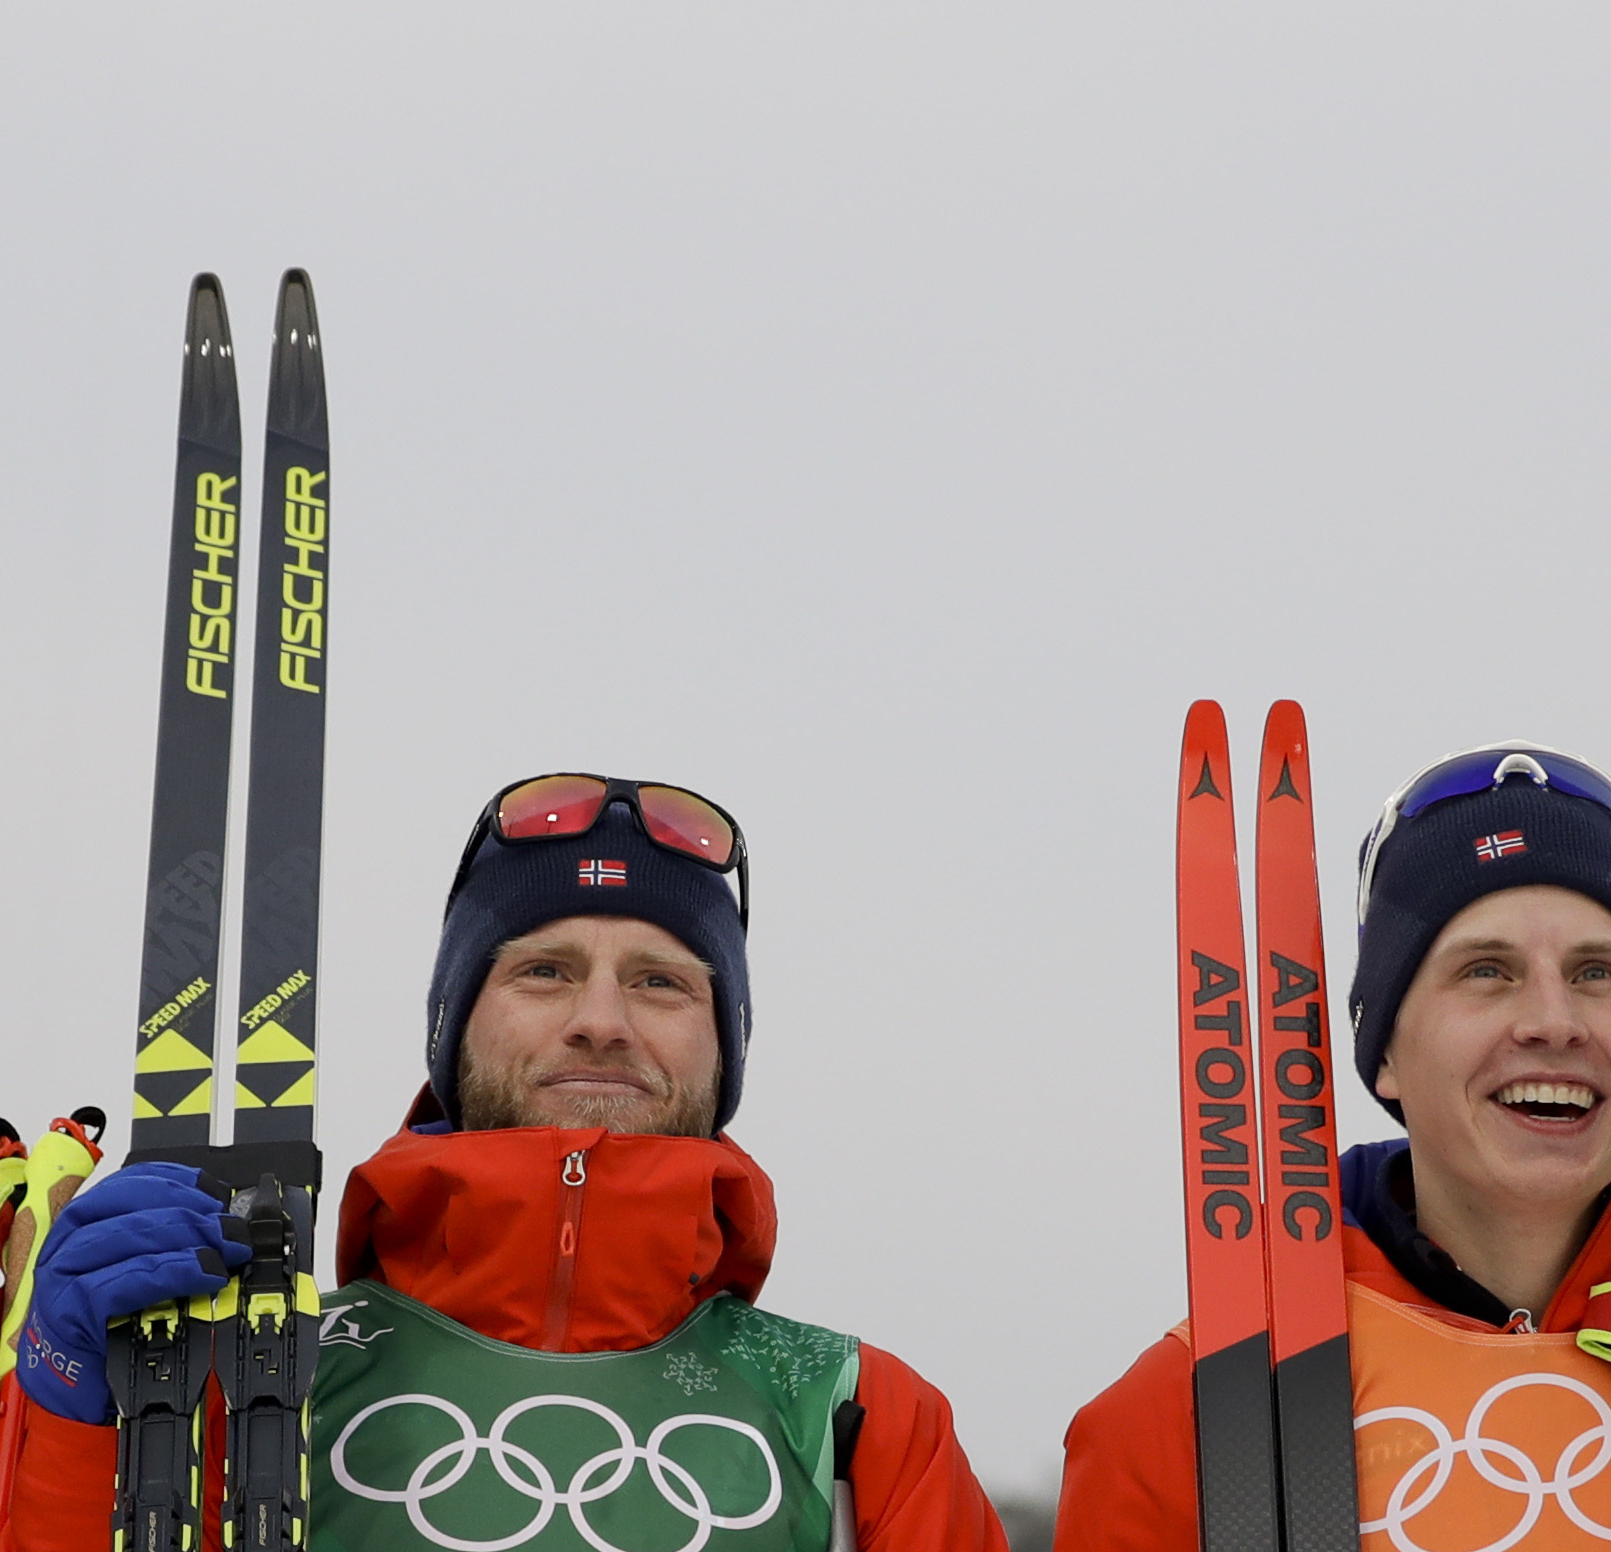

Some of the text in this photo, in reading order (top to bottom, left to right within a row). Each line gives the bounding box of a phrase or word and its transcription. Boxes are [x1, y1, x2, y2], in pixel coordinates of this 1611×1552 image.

[186, 472, 237, 699] FISCHER
[279, 465, 326, 694] FISCHER
[139, 1002, 181, 1039] SPEED
[175, 976, 211, 1011] MAX
[241, 994, 282, 1030] SPEED
[276, 969, 312, 1004] MAX
[1190, 950, 1253, 1240] ATOMIC
[1270, 950, 1332, 1243] ATOMIC
[258, 1504, 268, 1546] FISCHER
